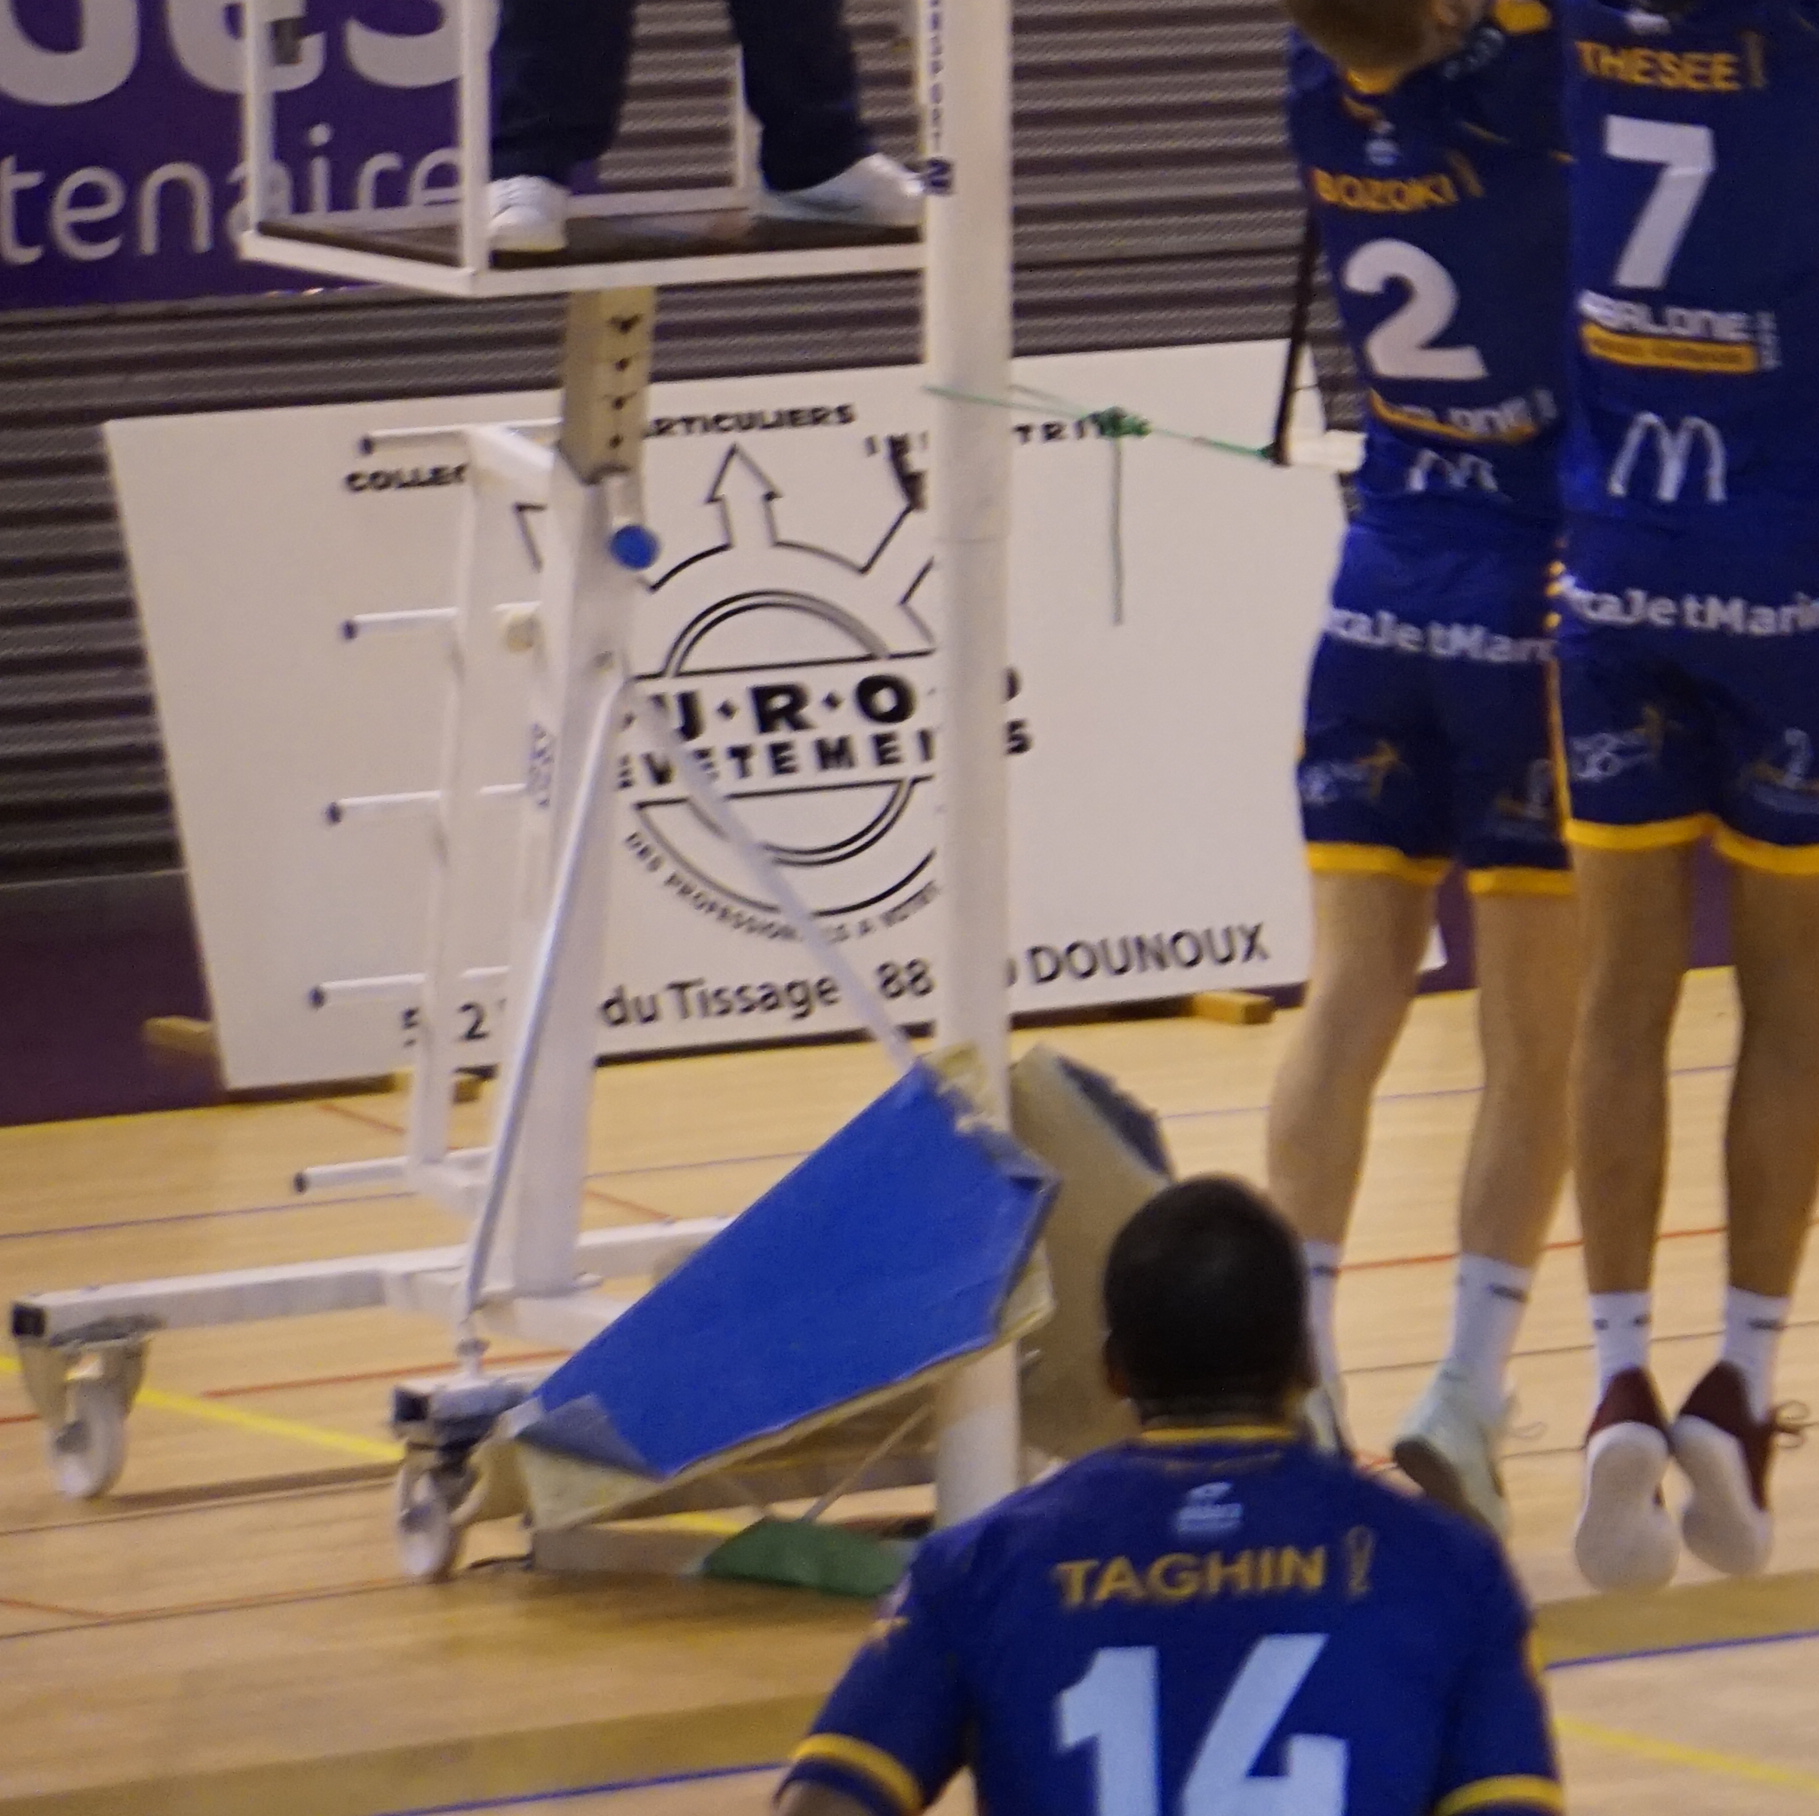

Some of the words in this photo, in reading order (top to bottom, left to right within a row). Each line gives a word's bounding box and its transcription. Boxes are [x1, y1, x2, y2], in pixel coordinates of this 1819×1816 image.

[1575, 40, 1741, 92] THESEE
[1604, 113, 1717, 290] 7
[1344, 237, 1488, 380] 2
[600, 984, 658, 1027] du
[666, 972, 840, 1020] Tissage
[1027, 921, 1270, 984] DOUNOUX
[1054, 1545, 1327, 1609] TAGHIN
[1057, 1633, 1348, 1816] 14
